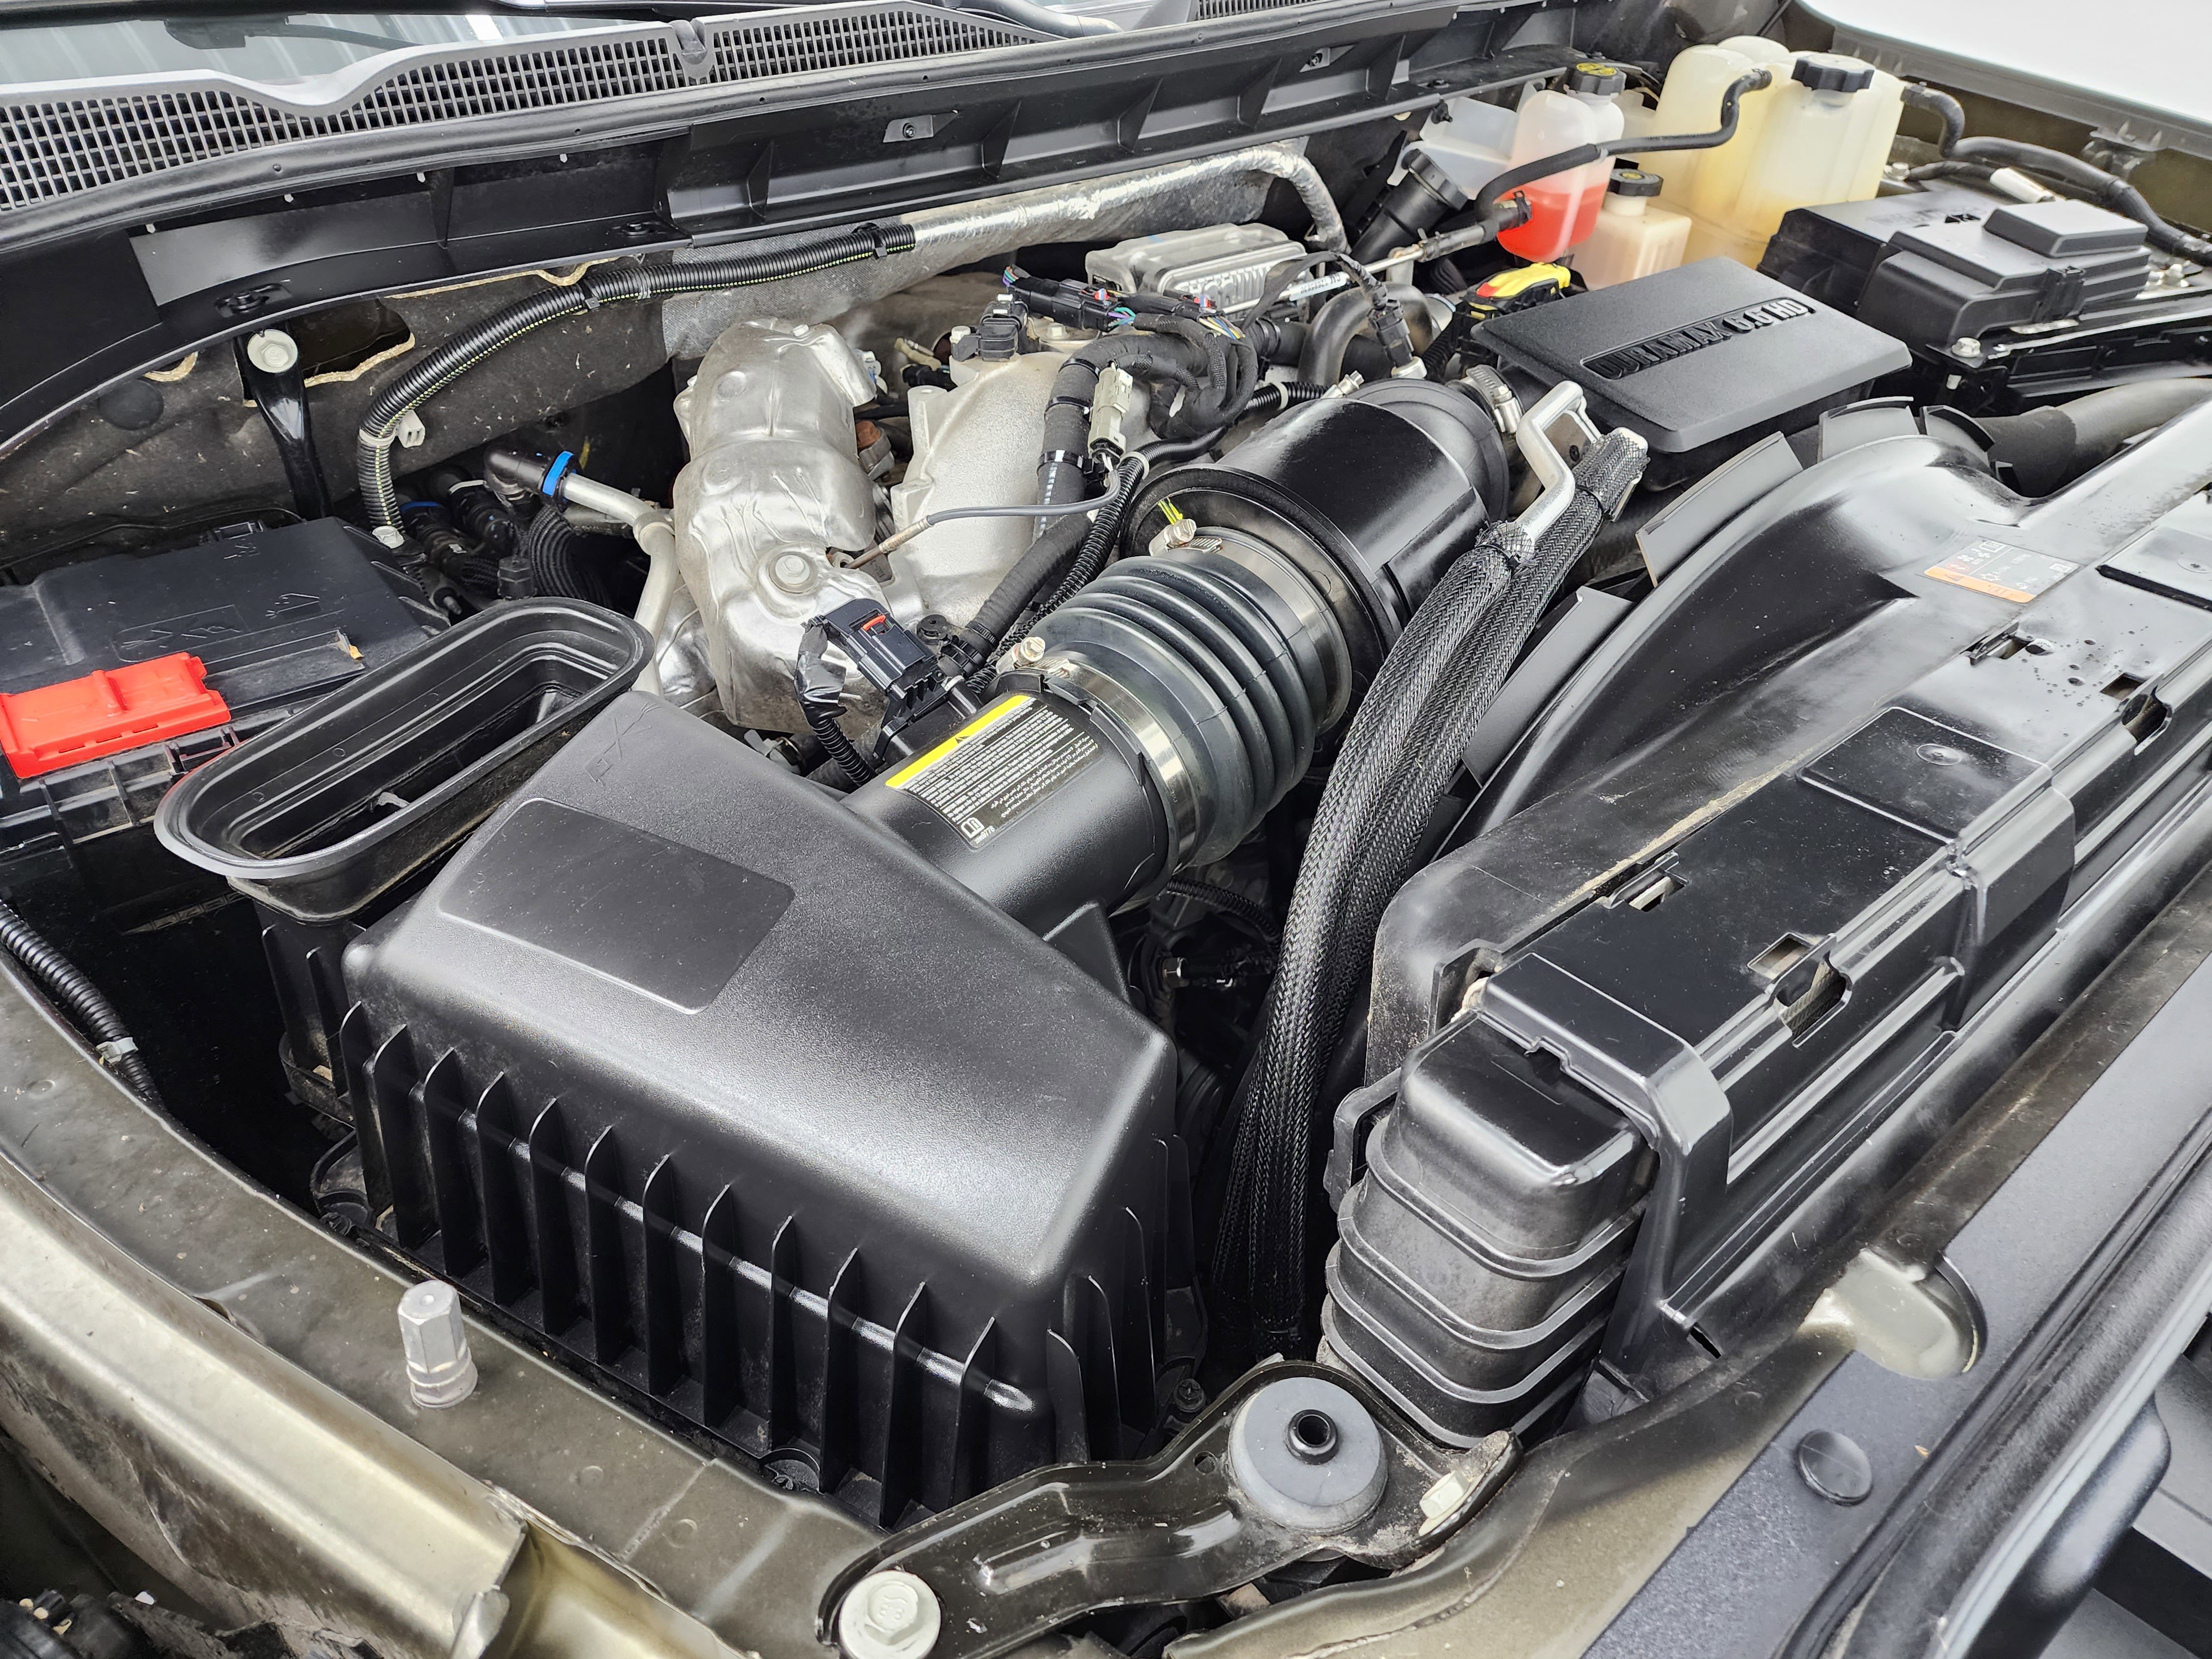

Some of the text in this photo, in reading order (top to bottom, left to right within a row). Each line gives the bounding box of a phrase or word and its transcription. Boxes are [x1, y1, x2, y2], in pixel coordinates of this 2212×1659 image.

[1593, 298, 1811, 380] DURAMAX 6.6 HD
